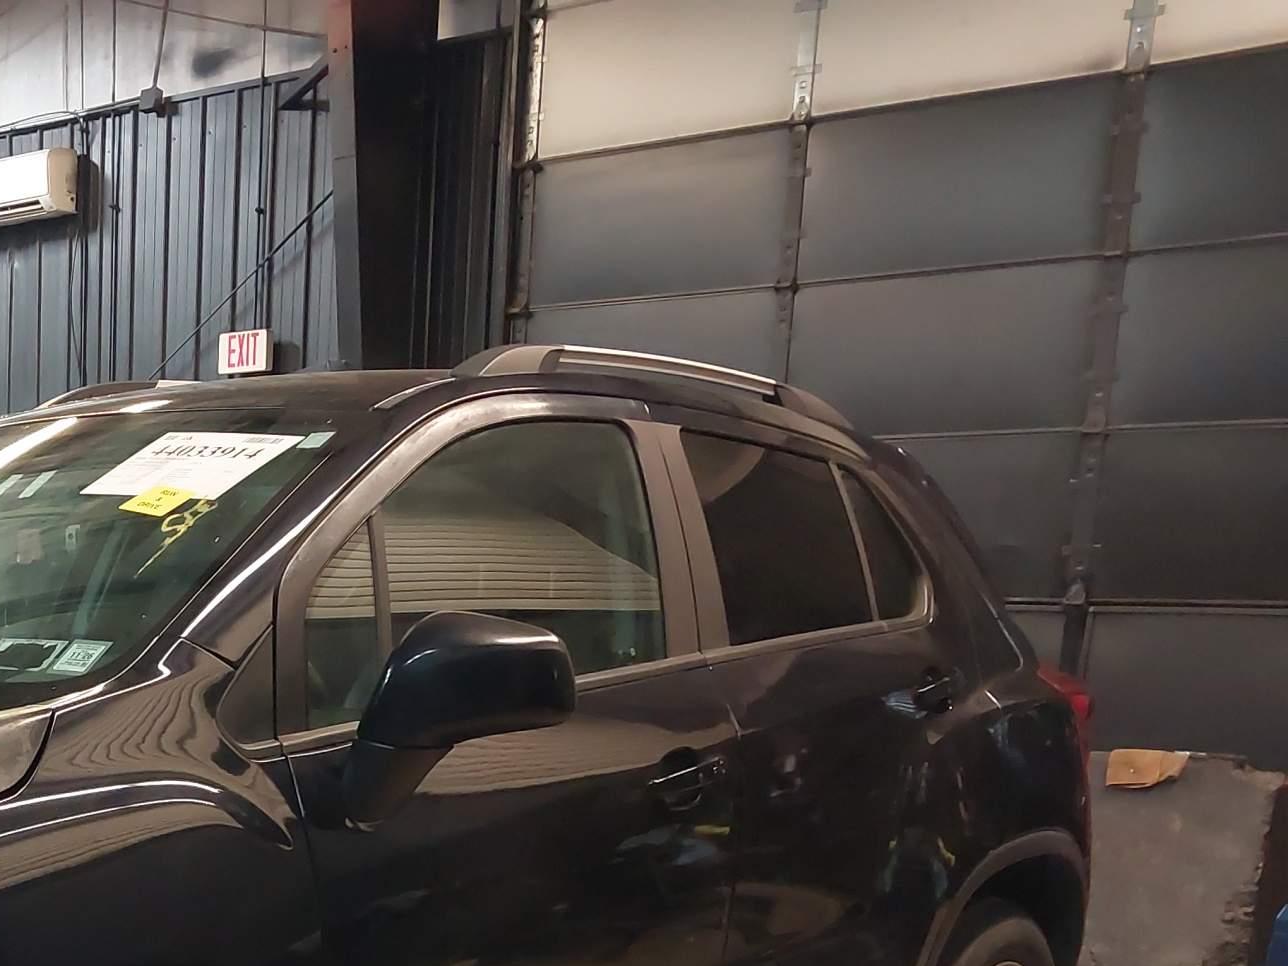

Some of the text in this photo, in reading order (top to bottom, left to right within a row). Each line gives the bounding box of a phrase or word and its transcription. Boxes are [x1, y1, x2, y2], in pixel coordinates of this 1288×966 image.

[228, 332, 259, 368] EXIT
[152, 445, 265, 459] 44033914
[137, 501, 162, 510] DRIVE
